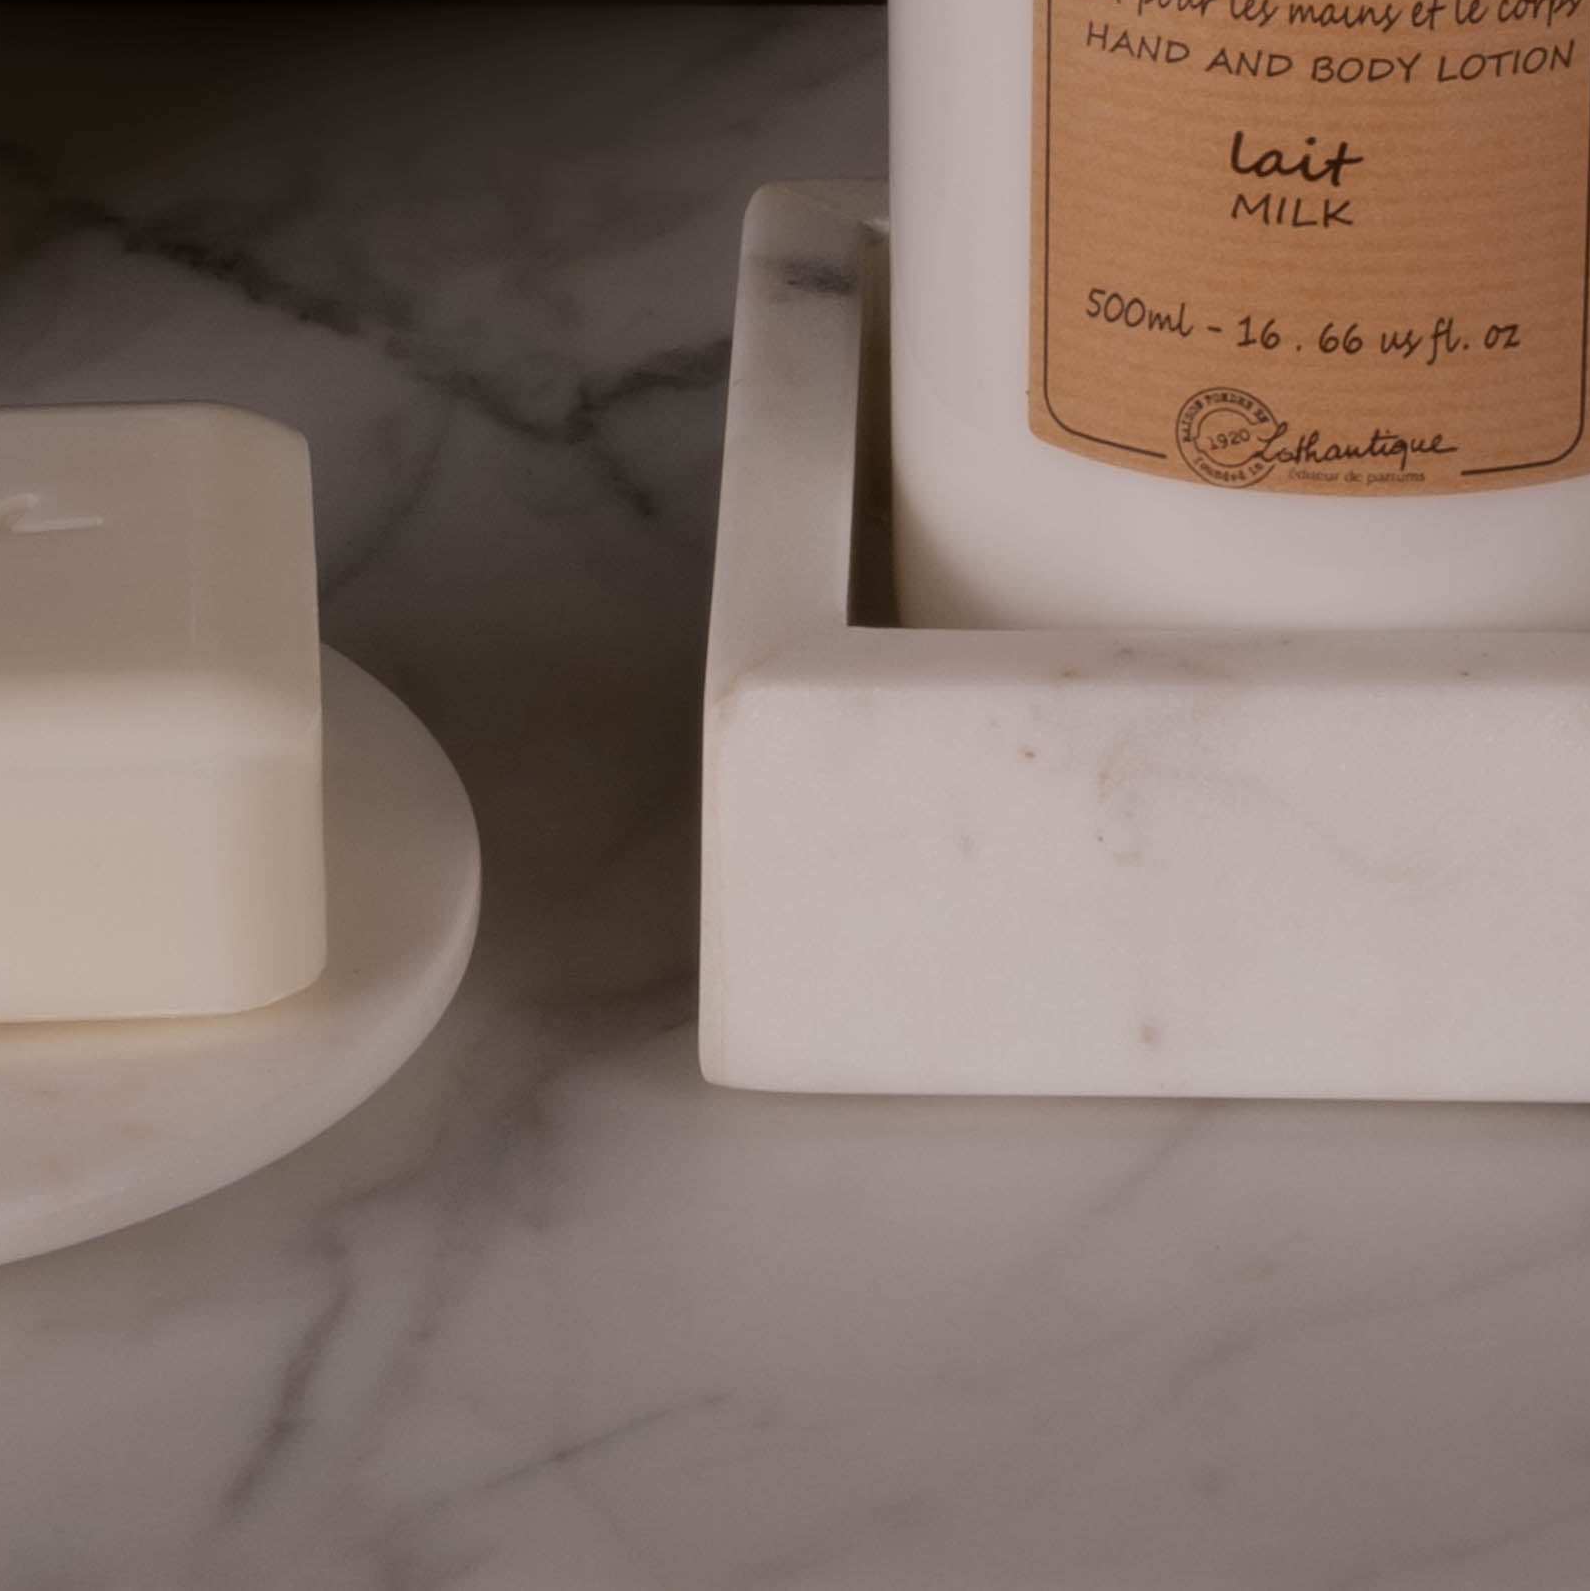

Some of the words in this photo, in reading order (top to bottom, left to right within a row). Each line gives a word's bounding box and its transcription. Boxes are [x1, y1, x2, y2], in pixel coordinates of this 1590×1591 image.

[1086, 21, 1190, 64] HAND
[1205, 47, 1293, 78] AND
[1311, 52, 1422, 83] BODY
[1437, 39, 1575, 82] LOTION
[1231, 130, 1364, 187] lait
[1231, 193, 1353, 229] MILK
[1085, 287, 1194, 338] 500ml
[1484, 323, 1521, 349] oz
[1207, 428, 1250, 450] 1920
[1251, 421, 1458, 471] Lothantique
